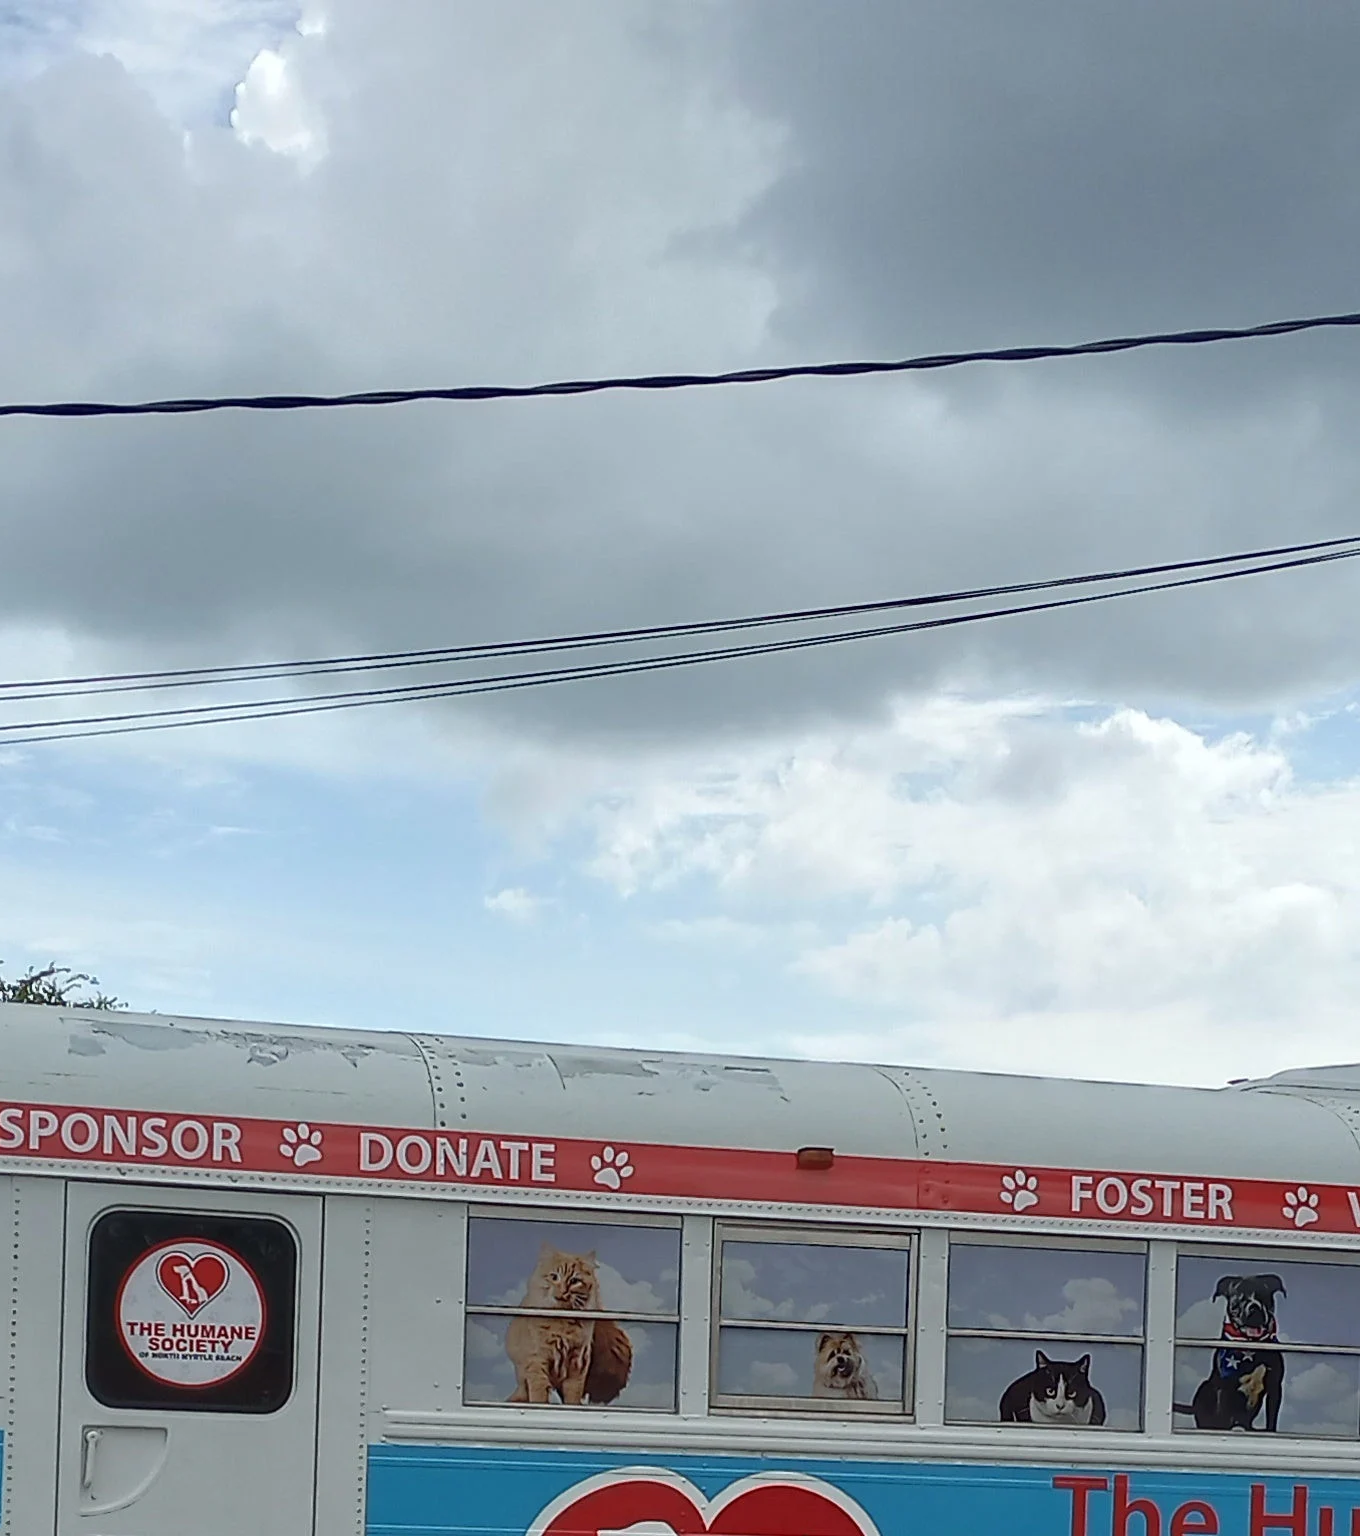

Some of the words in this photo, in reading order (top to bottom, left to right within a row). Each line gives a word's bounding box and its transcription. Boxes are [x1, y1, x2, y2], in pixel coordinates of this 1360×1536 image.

[358, 1131, 557, 1184] DONATE
[1070, 1174, 1235, 1222] FOSTER
[126, 1321, 166, 1336] THE
[172, 1323, 257, 1341] HUMANE
[148, 1337, 234, 1354] SOCIETY
